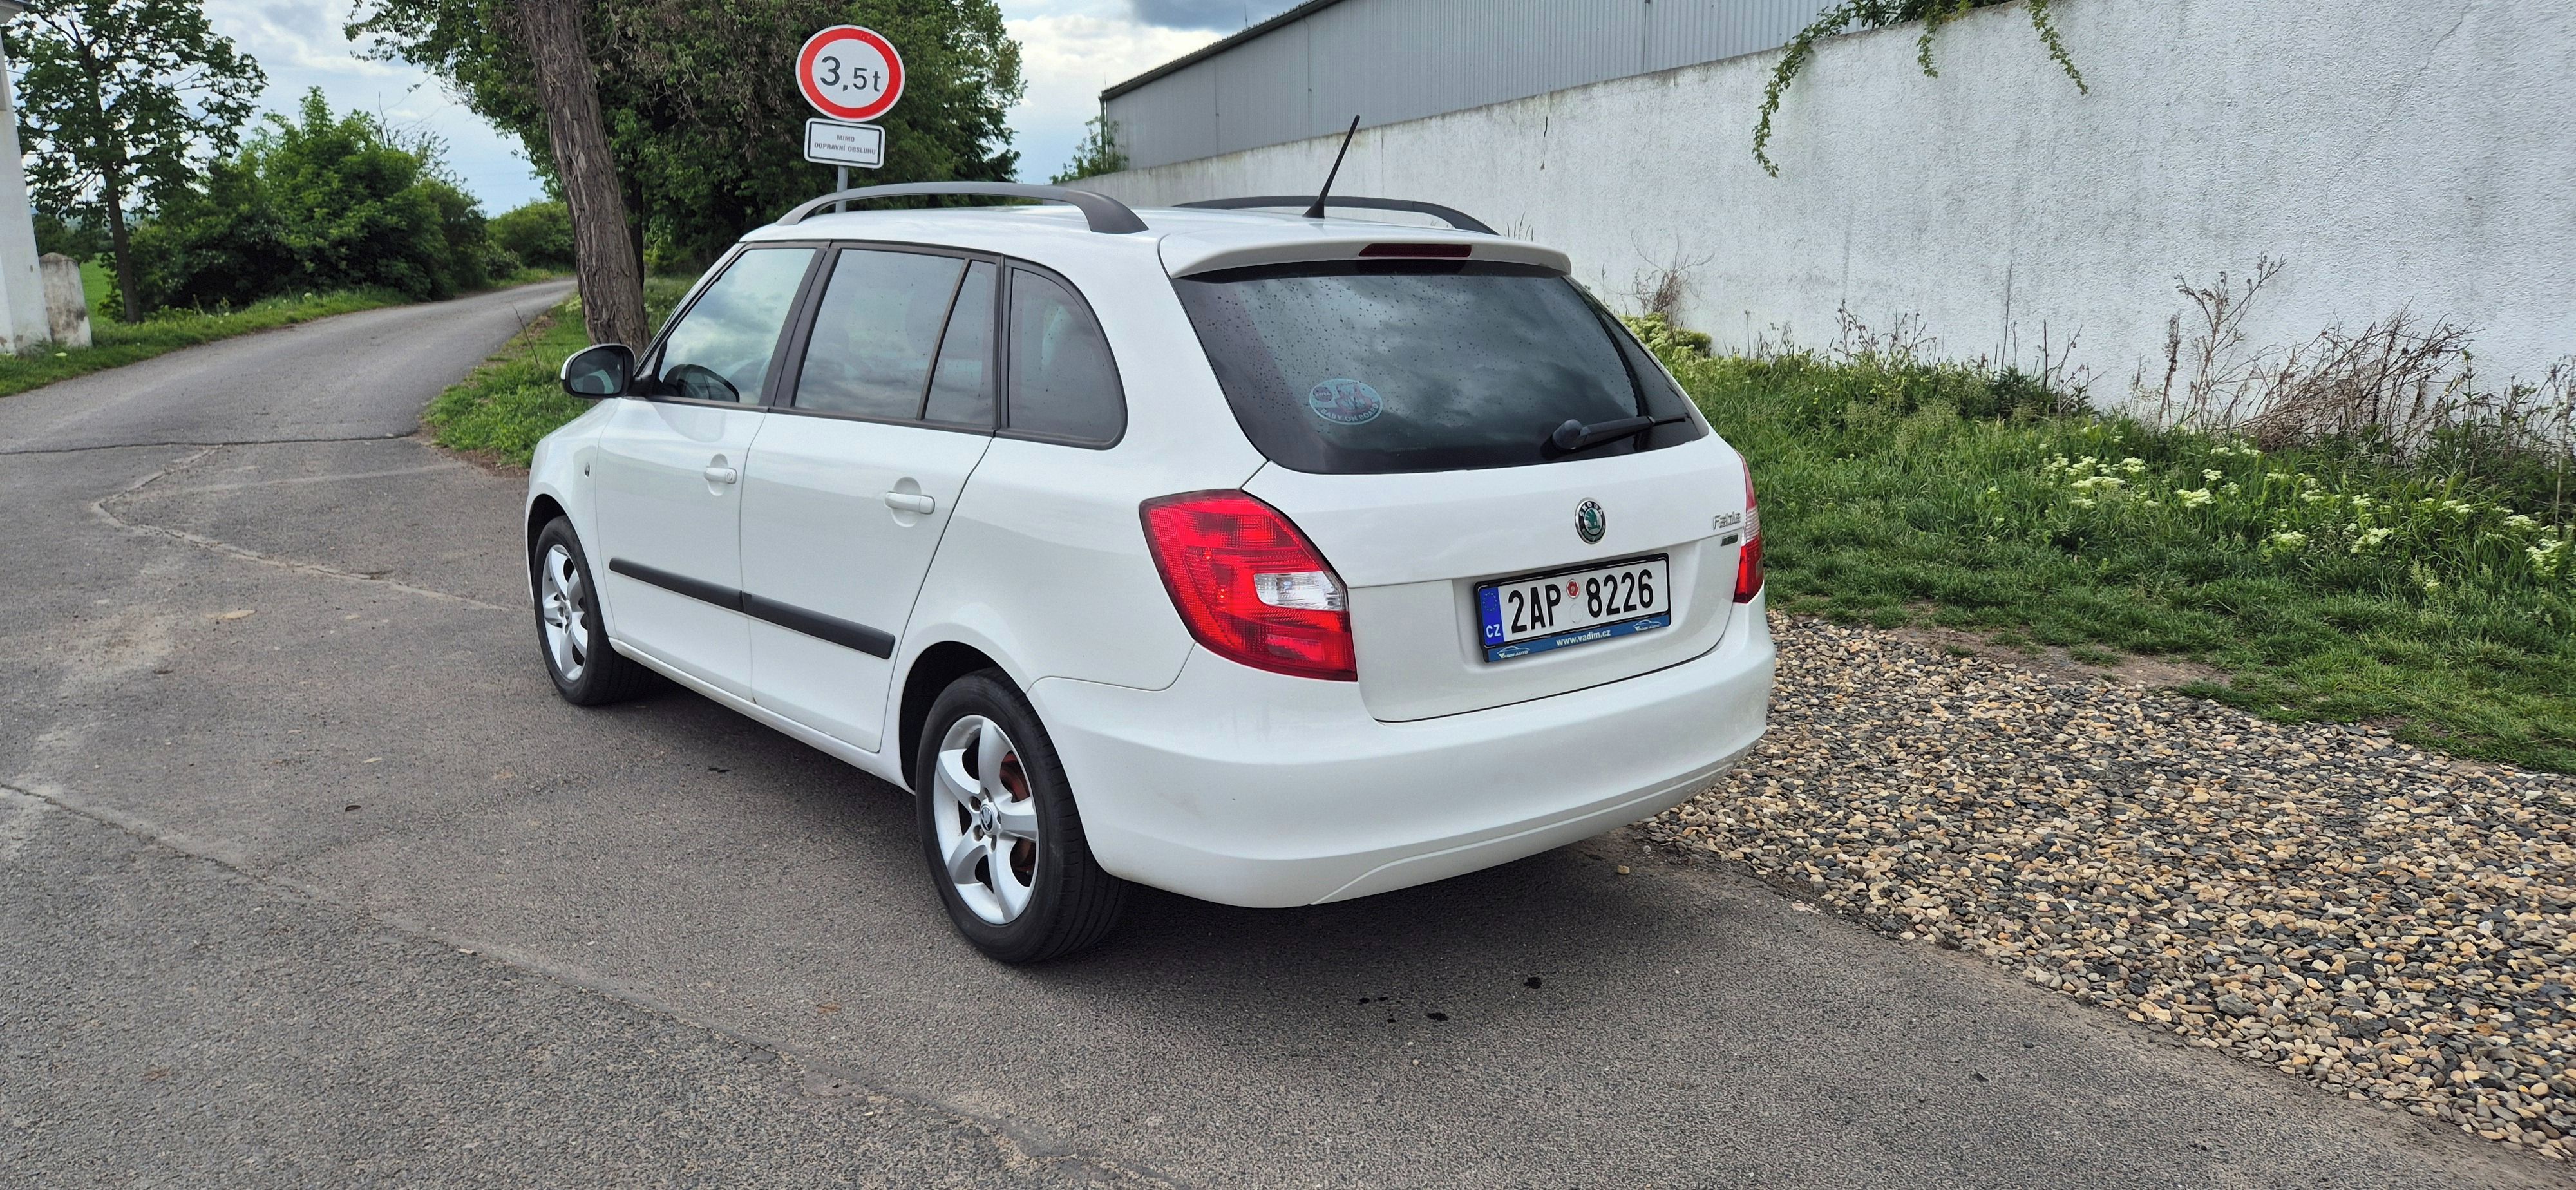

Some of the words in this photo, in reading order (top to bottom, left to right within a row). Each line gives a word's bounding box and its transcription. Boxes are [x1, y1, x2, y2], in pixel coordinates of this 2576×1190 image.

[814, 142, 846, 151] DOPRAVNÍ
[848, 146, 876, 155] OBSLUHU
[1320, 408, 1342, 421] BABY
[1359, 402, 1378, 420] BOARD
[1713, 511, 1741, 530] Fabia
[1508, 583, 1561, 634] 2AP
[1586, 569, 1654, 618] 8226
[1486, 623, 1501, 638] CZ
[1556, 630, 1611, 647] www.vadim.cz
